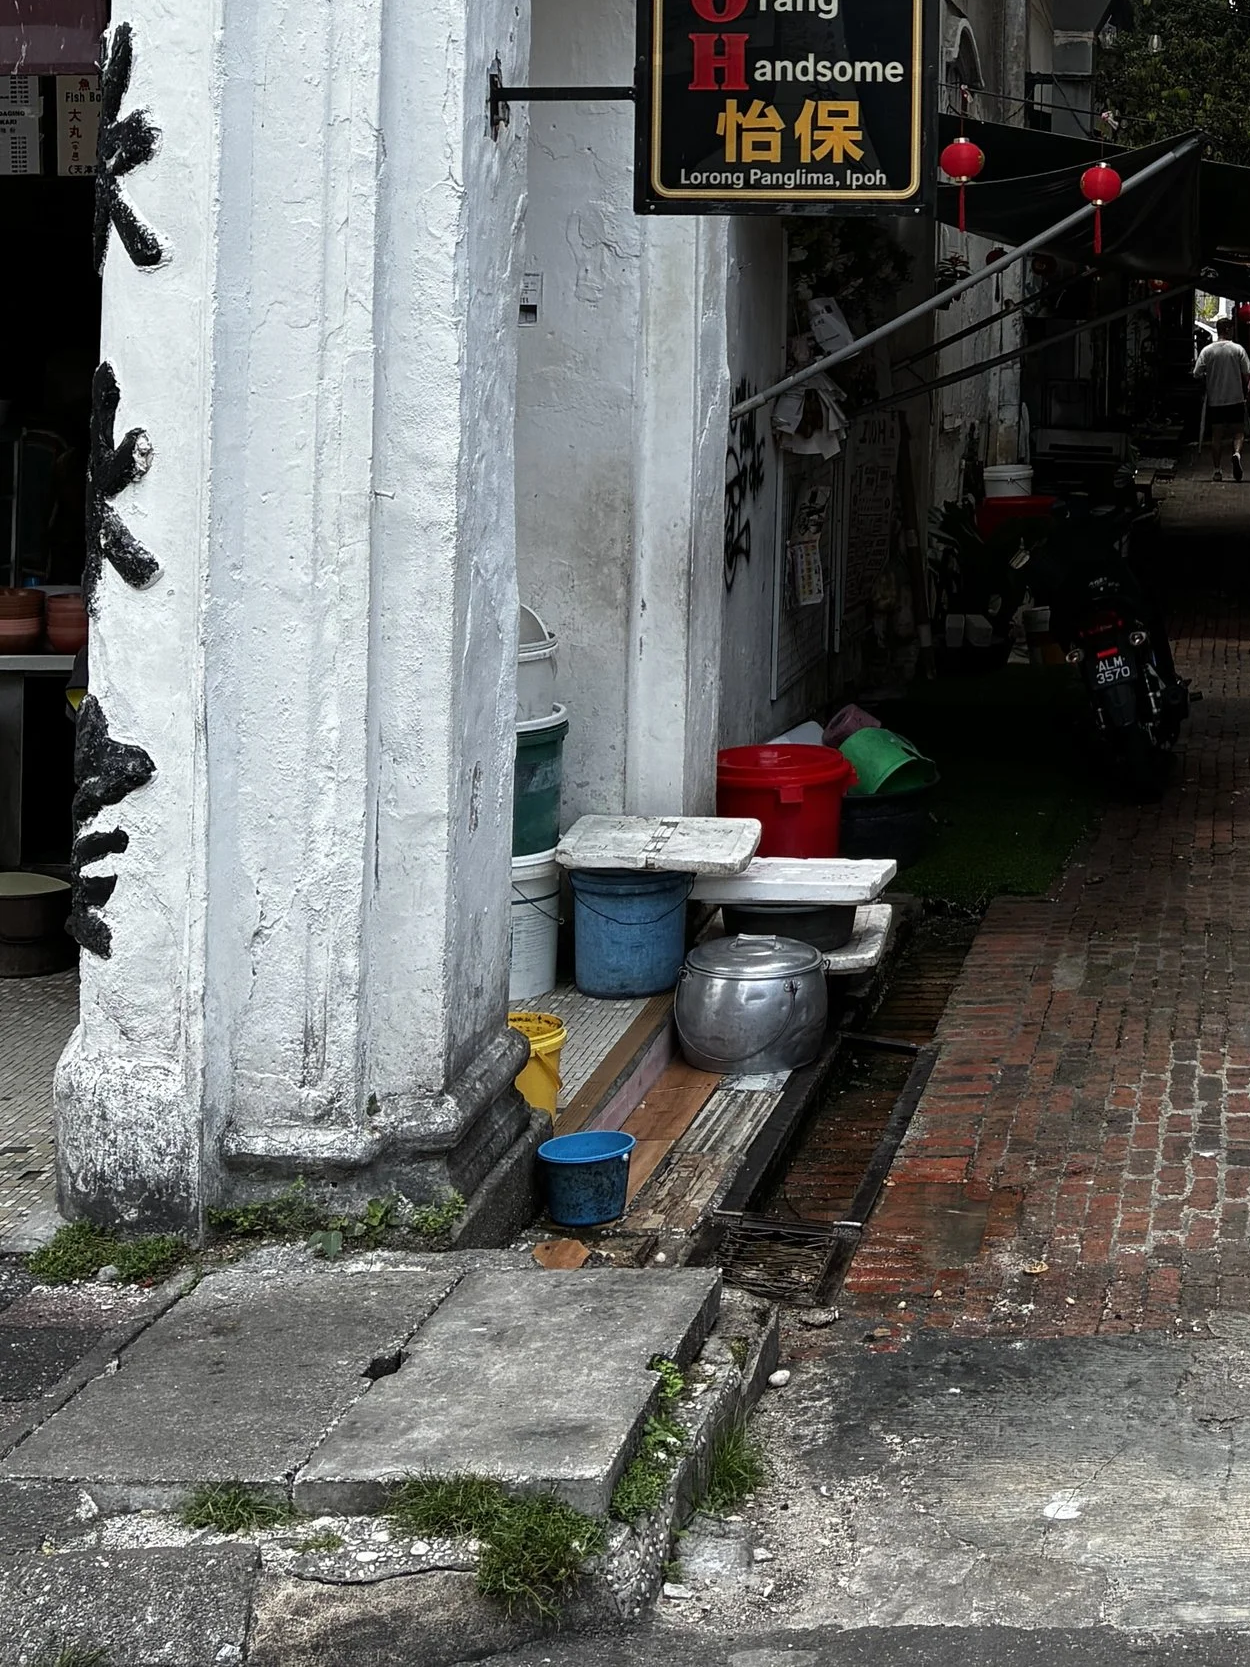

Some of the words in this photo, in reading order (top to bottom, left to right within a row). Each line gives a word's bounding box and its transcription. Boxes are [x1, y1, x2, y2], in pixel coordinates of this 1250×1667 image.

[65, 92, 85, 102] Fish
[716, 99, 865, 163] 怡保
[680, 168, 745, 188] Lorong
[750, 169, 841, 189] Panglima,
[846, 169, 887, 190] Ipoh
[1097, 655, 1124, 673] ALM
[1096, 666, 1131, 685] 3570
